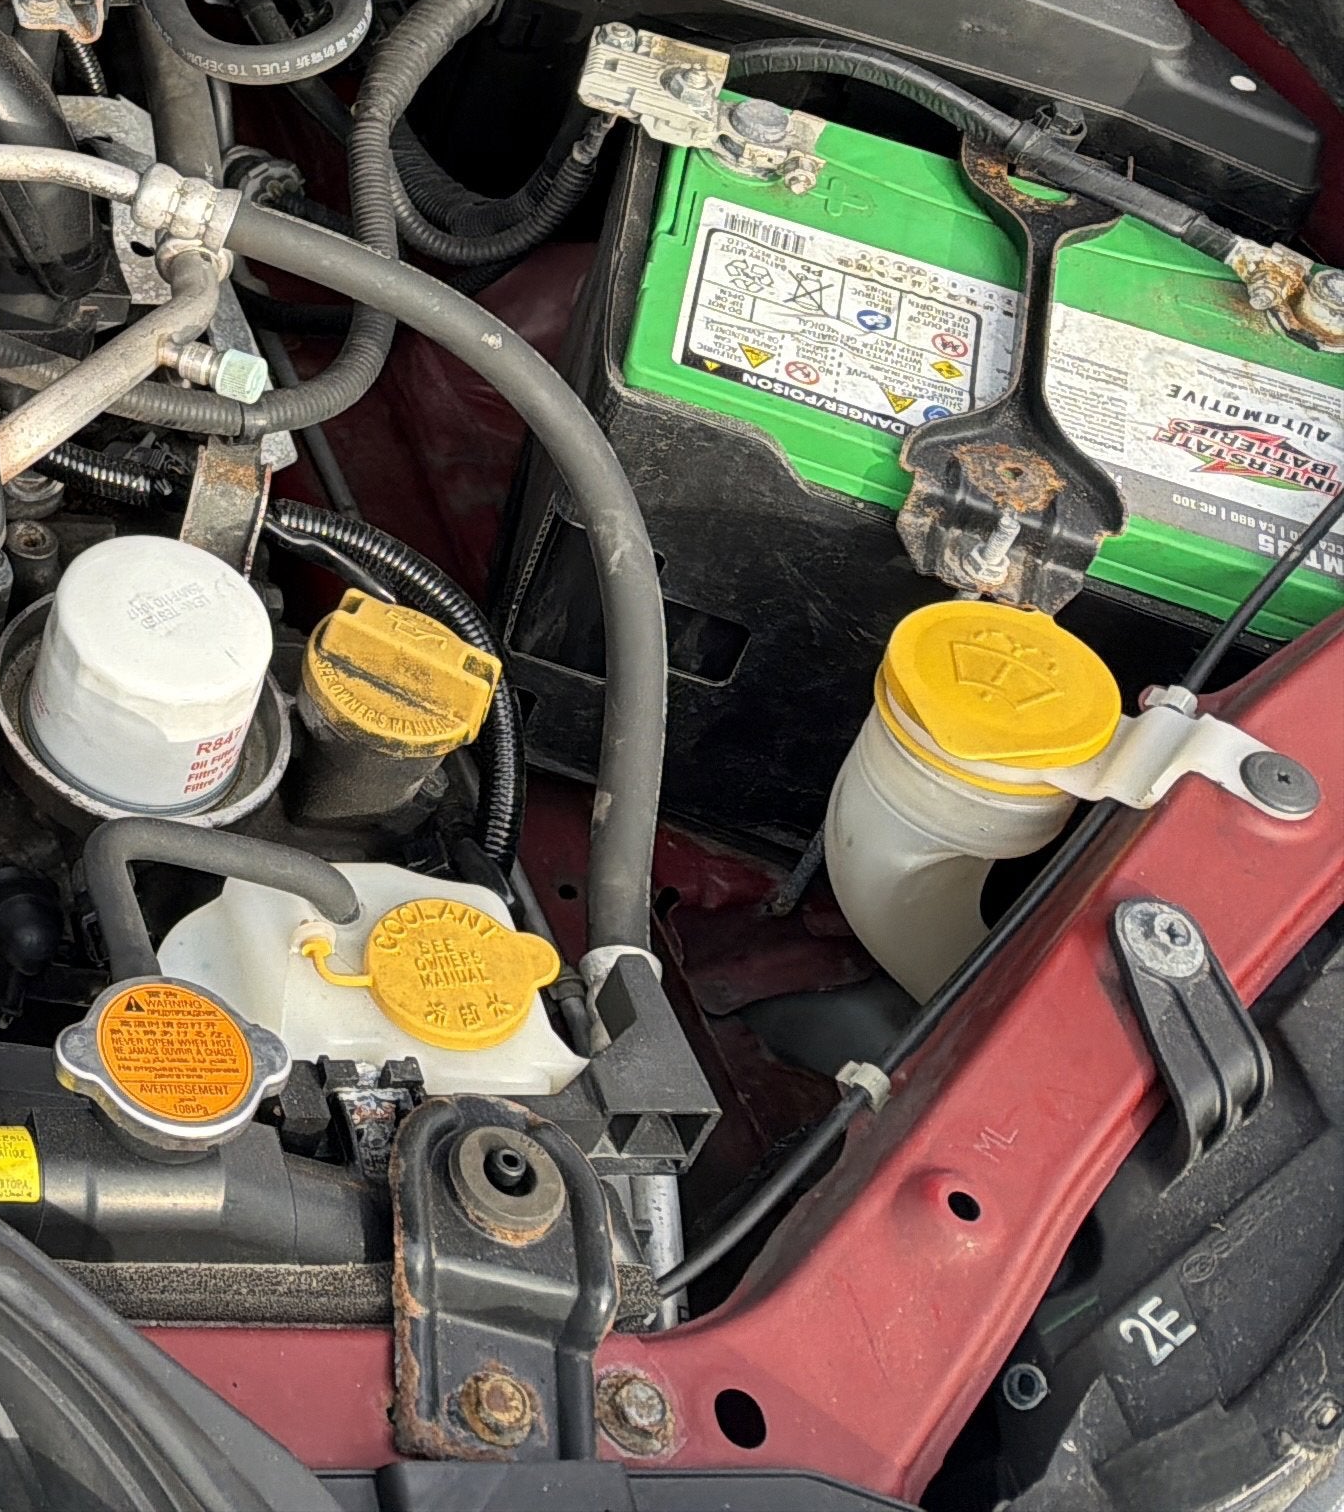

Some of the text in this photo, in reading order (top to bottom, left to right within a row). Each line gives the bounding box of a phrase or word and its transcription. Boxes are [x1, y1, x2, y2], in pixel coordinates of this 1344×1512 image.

[227, 60, 289, 75] FUEL TG
[739, 371, 906, 435] DANGER/POISON
[1164, 382, 1331, 443] AUTOMOTIVE
[1169, 417, 1331, 477] BATTERIES
[1154, 426, 1339, 495] INTERSTATE
[1170, 493, 1218, 515] RC 100
[1256, 519, 1276, 534] CA
[315, 657, 339, 686] SEE
[391, 717, 452, 737] MANUAL
[191, 760, 208, 771] Oil
[374, 903, 500, 953] COOLANT
[417, 939, 457, 955] SEE
[419, 968, 492, 990] MANUAL
[144, 999, 202, 1008] WARNING
[128, 1048, 158, 1056] JAMAIS
[148, 1038, 174, 1047] OPEN
[178, 1039, 208, 1047] WHEN
[140, 1083, 229, 1095] AVERTISSEMENT
[173, 1104, 210, 1115] 108kPa
[973, 1126, 1019, 1163] ML
[1119, 1296, 1197, 1366] 2E
